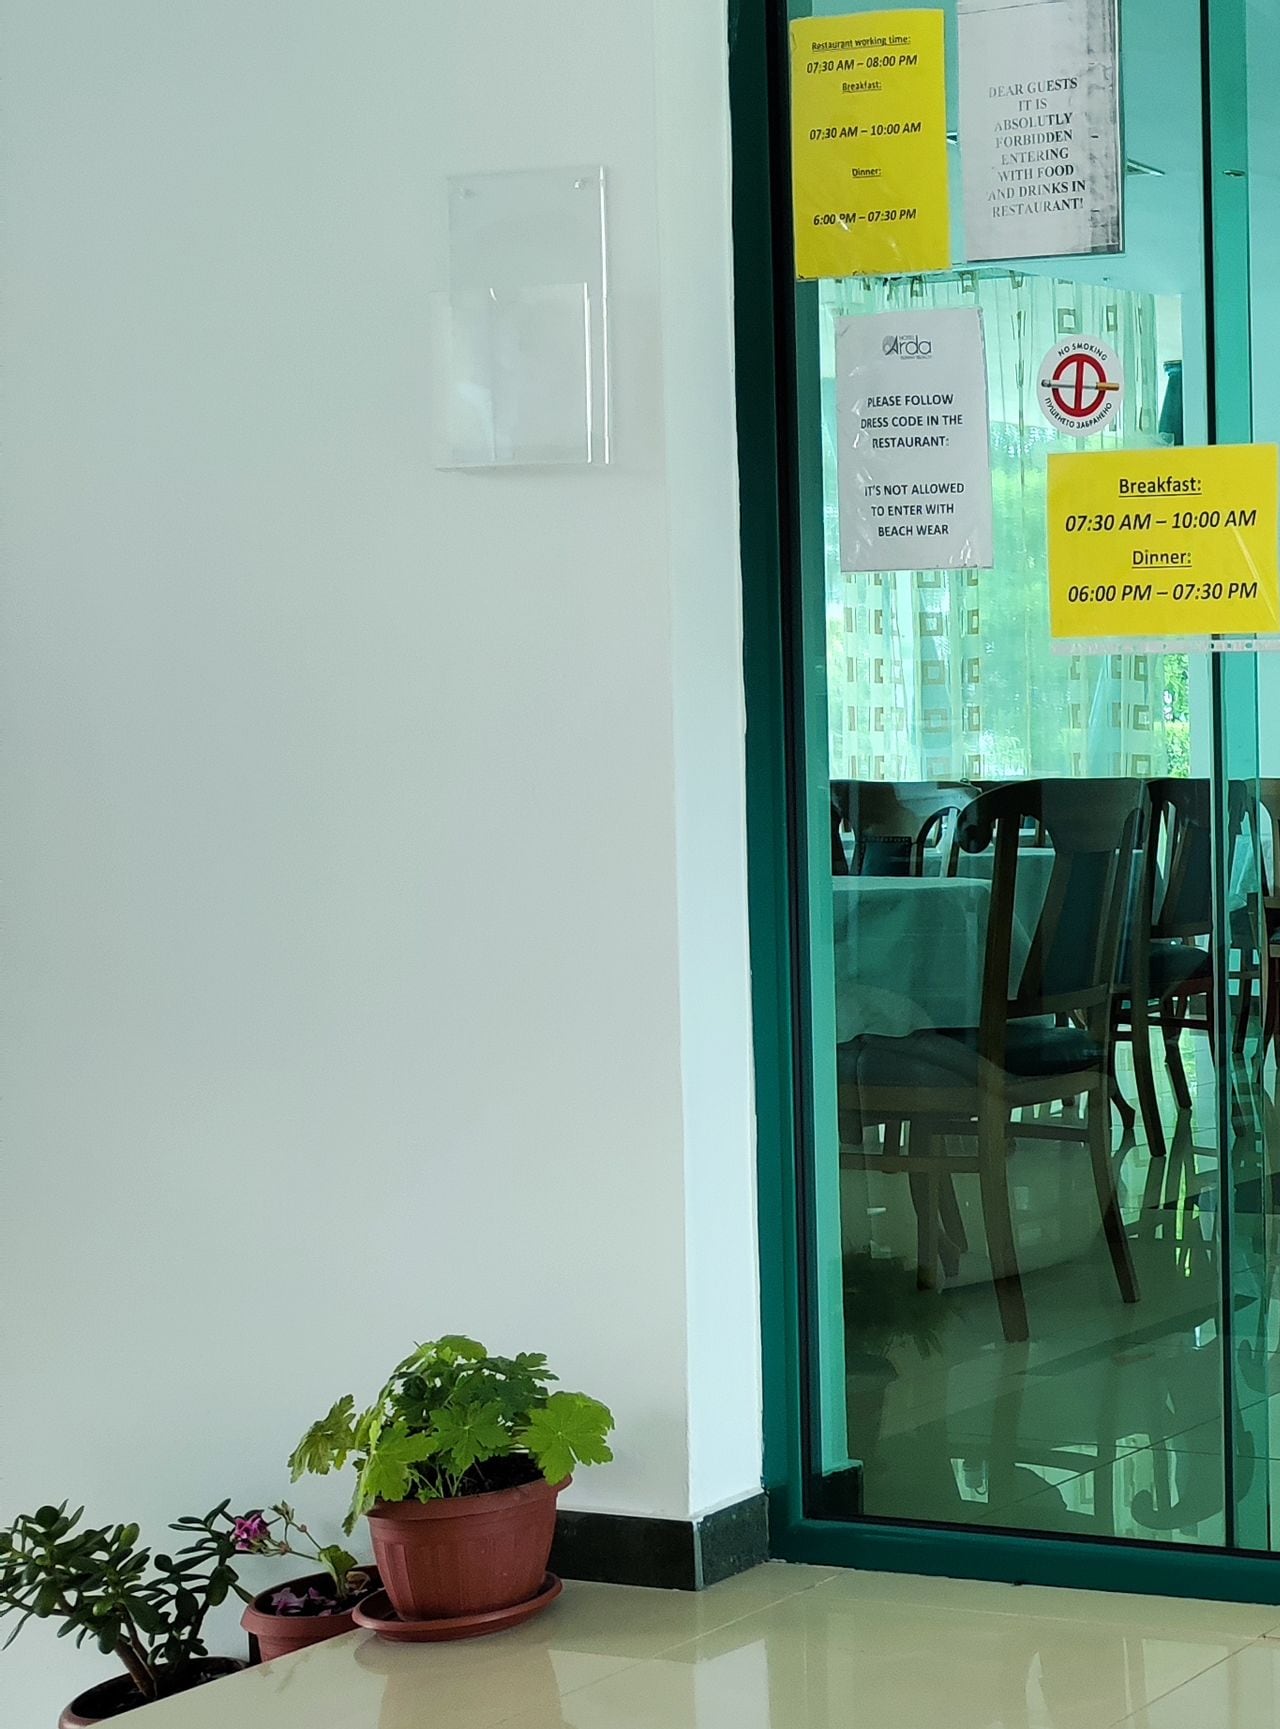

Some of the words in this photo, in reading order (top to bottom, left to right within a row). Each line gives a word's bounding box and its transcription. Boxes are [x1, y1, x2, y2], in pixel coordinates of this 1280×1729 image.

[811, 40, 853, 51] Restaurant
[854, 36, 887, 47] working
[888, 34, 911, 45] time:
[807, 61, 834, 73] 07:30
[836, 59, 855, 71] AM
[866, 56, 896, 68] 08:00
[899, 55, 918, 66] PM
[842, 81, 882, 92] Breakfast:
[988, 82, 1024, 98] DEAR
[1027, 77, 1078, 94] GUESTS
[1018, 99, 1032, 112] IT
[1035, 98, 1048, 110] IS
[810, 128, 837, 140] 07:30
[839, 126, 858, 138] AM
[870, 123, 901, 136] 10:00
[903, 122, 922, 134] AM
[994, 112, 1073, 132] ABSOLUTLY
[995, 129, 1073, 149] FORBIDDEN
[1001, 147, 1069, 166] ENTERING
[852, 167, 882, 177] Dinner:
[998, 168, 1034, 183] WITH
[1037, 164, 1074, 179] FOOD
[988, 187, 1015, 201] AND
[1019, 182, 1069, 198] DRINKS
[1072, 180, 1086, 192] IN
[813, 214, 836, 225] 6:00
[838, 212, 856, 224] PM
[868, 210, 897, 222] 07:30
[899, 208, 917, 220] PM
[992, 198, 1084, 218] RESTAURANT!
[885, 334, 931, 355] Arda
[1058, 346, 1071, 357] NO
[1072, 342, 1108, 361] SMOKING
[867, 395, 902, 408] PLEASE
[904, 394, 954, 406] FOLLOW
[860, 418, 889, 429] DRESS
[891, 416, 923, 427] CODE
[926, 415, 939, 426] IN
[942, 414, 963, 426] THE
[872, 435, 949, 449] RESTAURANT:
[883, 484, 908, 496] NOT
[911, 483, 965, 496] ALLOWED
[1118, 476, 1202, 495] Breakfast:
[871, 505, 885, 517] TO
[888, 504, 923, 516] ENTER
[925, 503, 954, 515] WITH
[1065, 514, 1115, 532] 07:30
[1119, 513, 1151, 531] AM
[1171, 510, 1221, 529] 10:00
[1224, 509, 1257, 527] AM
[878, 525, 913, 537] BEACH
[916, 524, 949, 536] WEAR
[1132, 550, 1192, 566] Dinner:
[1068, 585, 1116, 602] 06:00
[1121, 584, 1152, 601] PM
[1173, 583, 1223, 600] 07:30
[1228, 582, 1258, 599] PM
